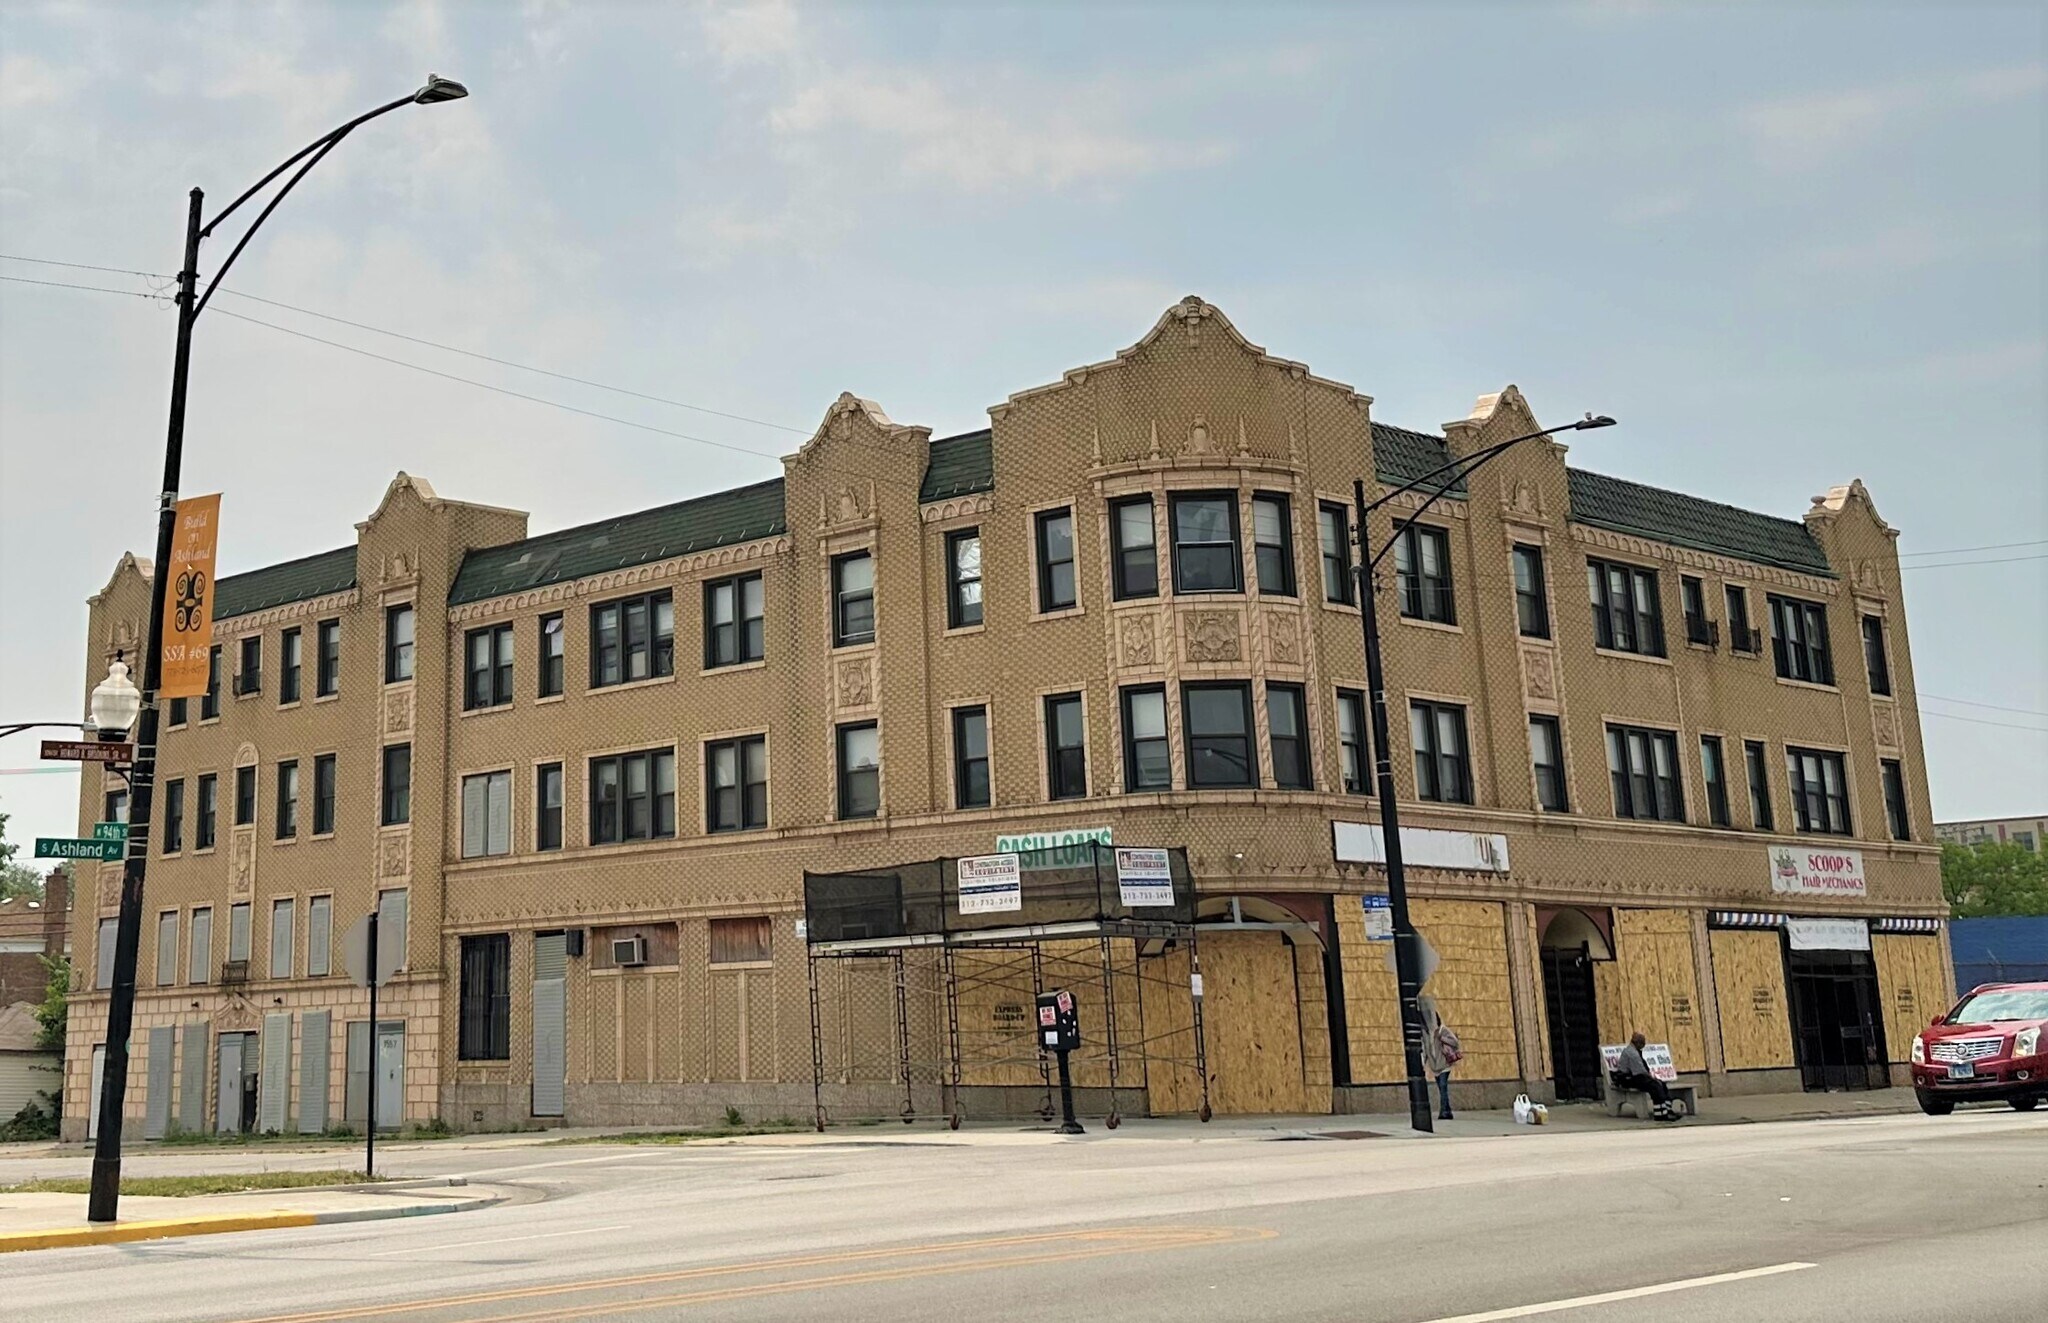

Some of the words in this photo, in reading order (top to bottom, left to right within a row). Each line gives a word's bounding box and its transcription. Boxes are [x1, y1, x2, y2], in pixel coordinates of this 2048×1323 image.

[184, 509, 210, 529] Build
[188, 532, 199, 544] on
[174, 541, 213, 563] Ashland
[164, 645, 186, 662] SSA
[189, 643, 208, 662] #69
[103, 825, 120, 839] 94th
[41, 843, 48, 853] S
[50, 841, 103, 857] Ashland
[107, 846, 118, 855] Av
[1808, 854, 1854, 873] SCOOP'S
[1802, 874, 1821, 887] HAIR
[1821, 876, 1864, 889] MECHANICS
